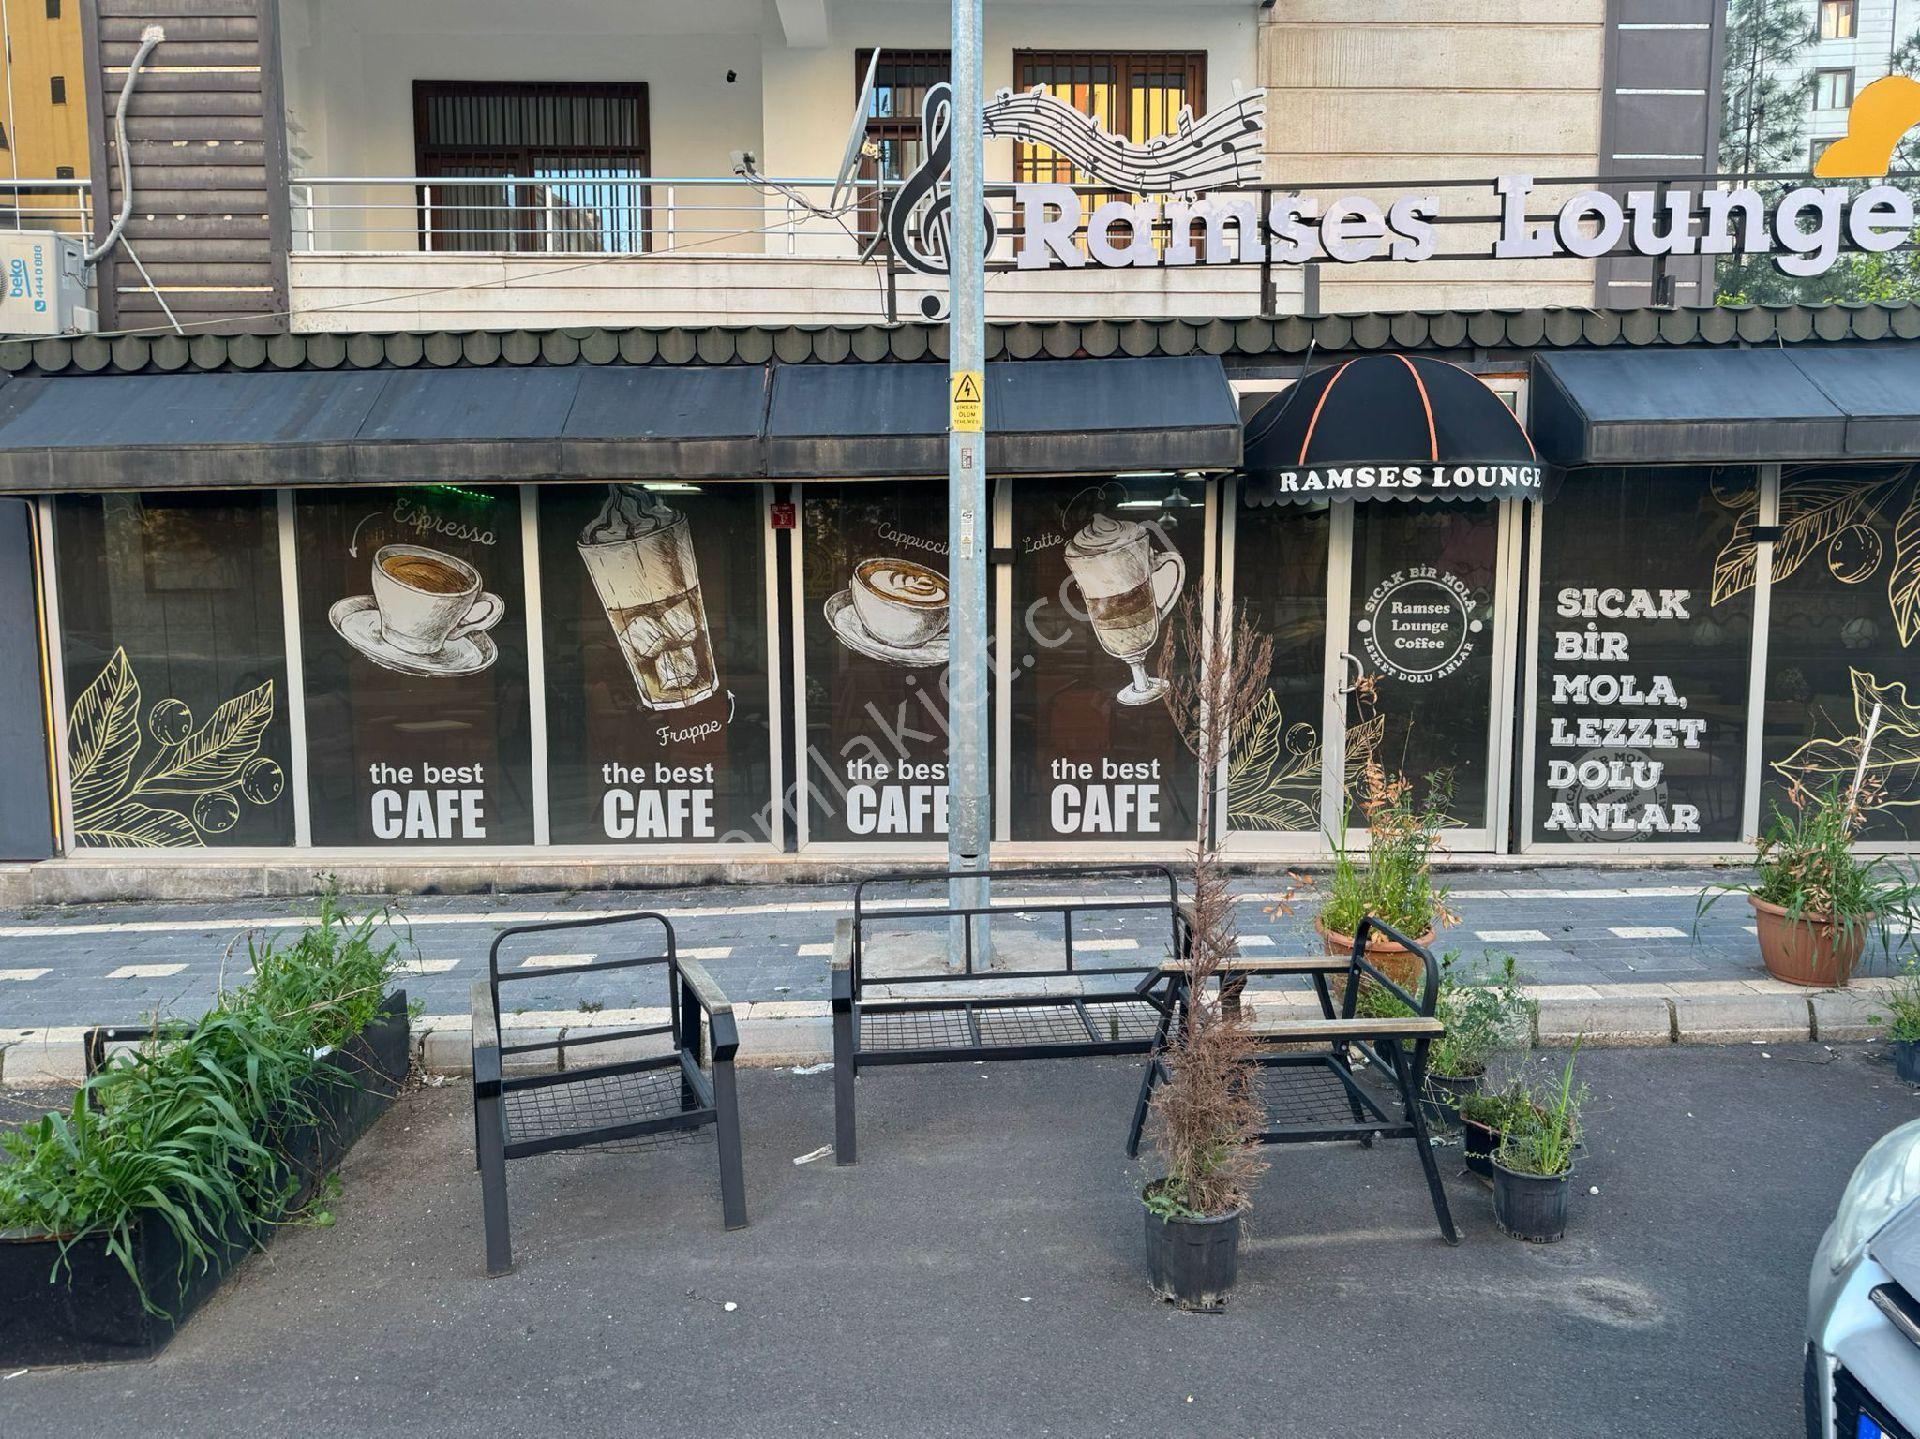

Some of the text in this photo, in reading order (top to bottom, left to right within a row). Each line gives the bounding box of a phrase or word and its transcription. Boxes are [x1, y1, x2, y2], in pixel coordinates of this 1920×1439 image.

[1016, 174, 1914, 276] Ramses Lounge
[10, 259, 23, 298] beko
[1280, 467, 1541, 492] RAMSES LOUNGE
[393, 497, 497, 546] Espresso
[877, 522, 949, 556] Cappucci
[1022, 532, 1064, 554] Latte
[1365, 563, 1478, 614] SICAK BİR MOLA
[1556, 588, 1691, 620] SICAK
[1391, 601, 1450, 614] Ramses
[1391, 619, 1449, 634] Lounge
[1554, 621, 1630, 662] BİR
[1394, 637, 1445, 649] Coffee
[1364, 637, 1474, 683] LEZZET DOLU ANLAR
[1551, 674, 1688, 711] MOLA,
[656, 720, 722, 747] Frappe
[1549, 717, 1707, 749] LEZZET
[369, 762, 485, 785] the best
[602, 762, 714, 785] the best
[847, 757, 949, 780] the bes
[1051, 757, 1160, 780] the best
[1546, 760, 1664, 790] DOLU
[371, 790, 486, 839] CAFE
[603, 789, 715, 838] CAFE
[847, 785, 949, 835] CAFE
[1051, 784, 1160, 834] CAFE
[1544, 802, 1701, 833] ANLAR
